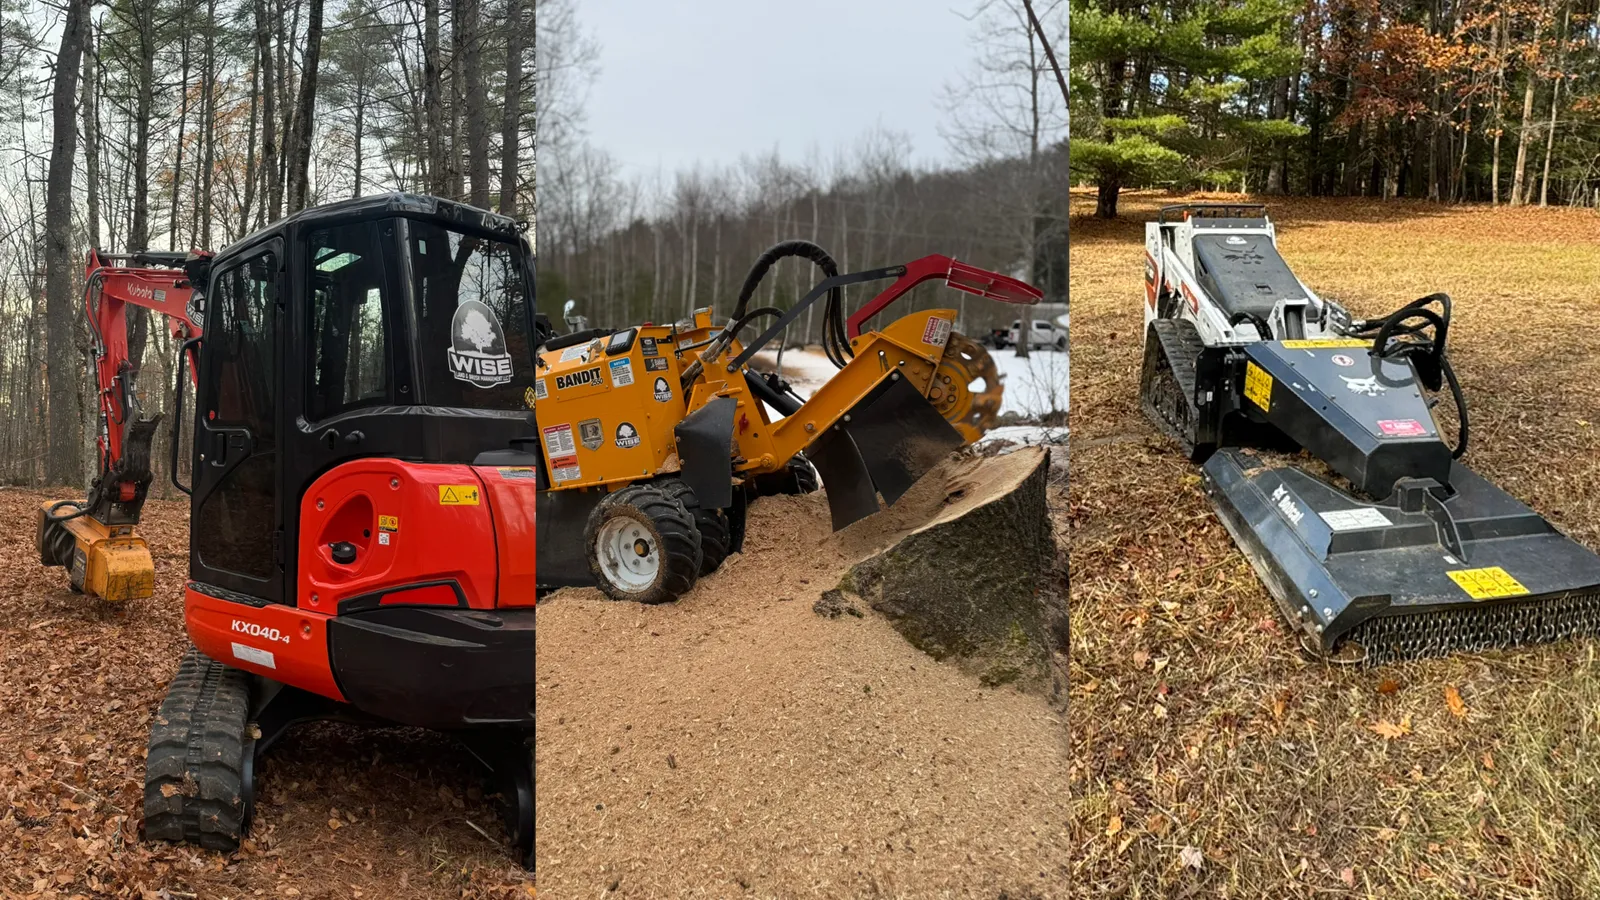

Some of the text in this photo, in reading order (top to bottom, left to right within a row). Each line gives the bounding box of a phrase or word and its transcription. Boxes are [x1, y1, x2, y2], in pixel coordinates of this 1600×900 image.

[127, 282, 153, 299] Kubota
[451, 353, 511, 375] WISE
[556, 367, 601, 389] BANDIT
[231, 619, 290, 644] KX040-4
